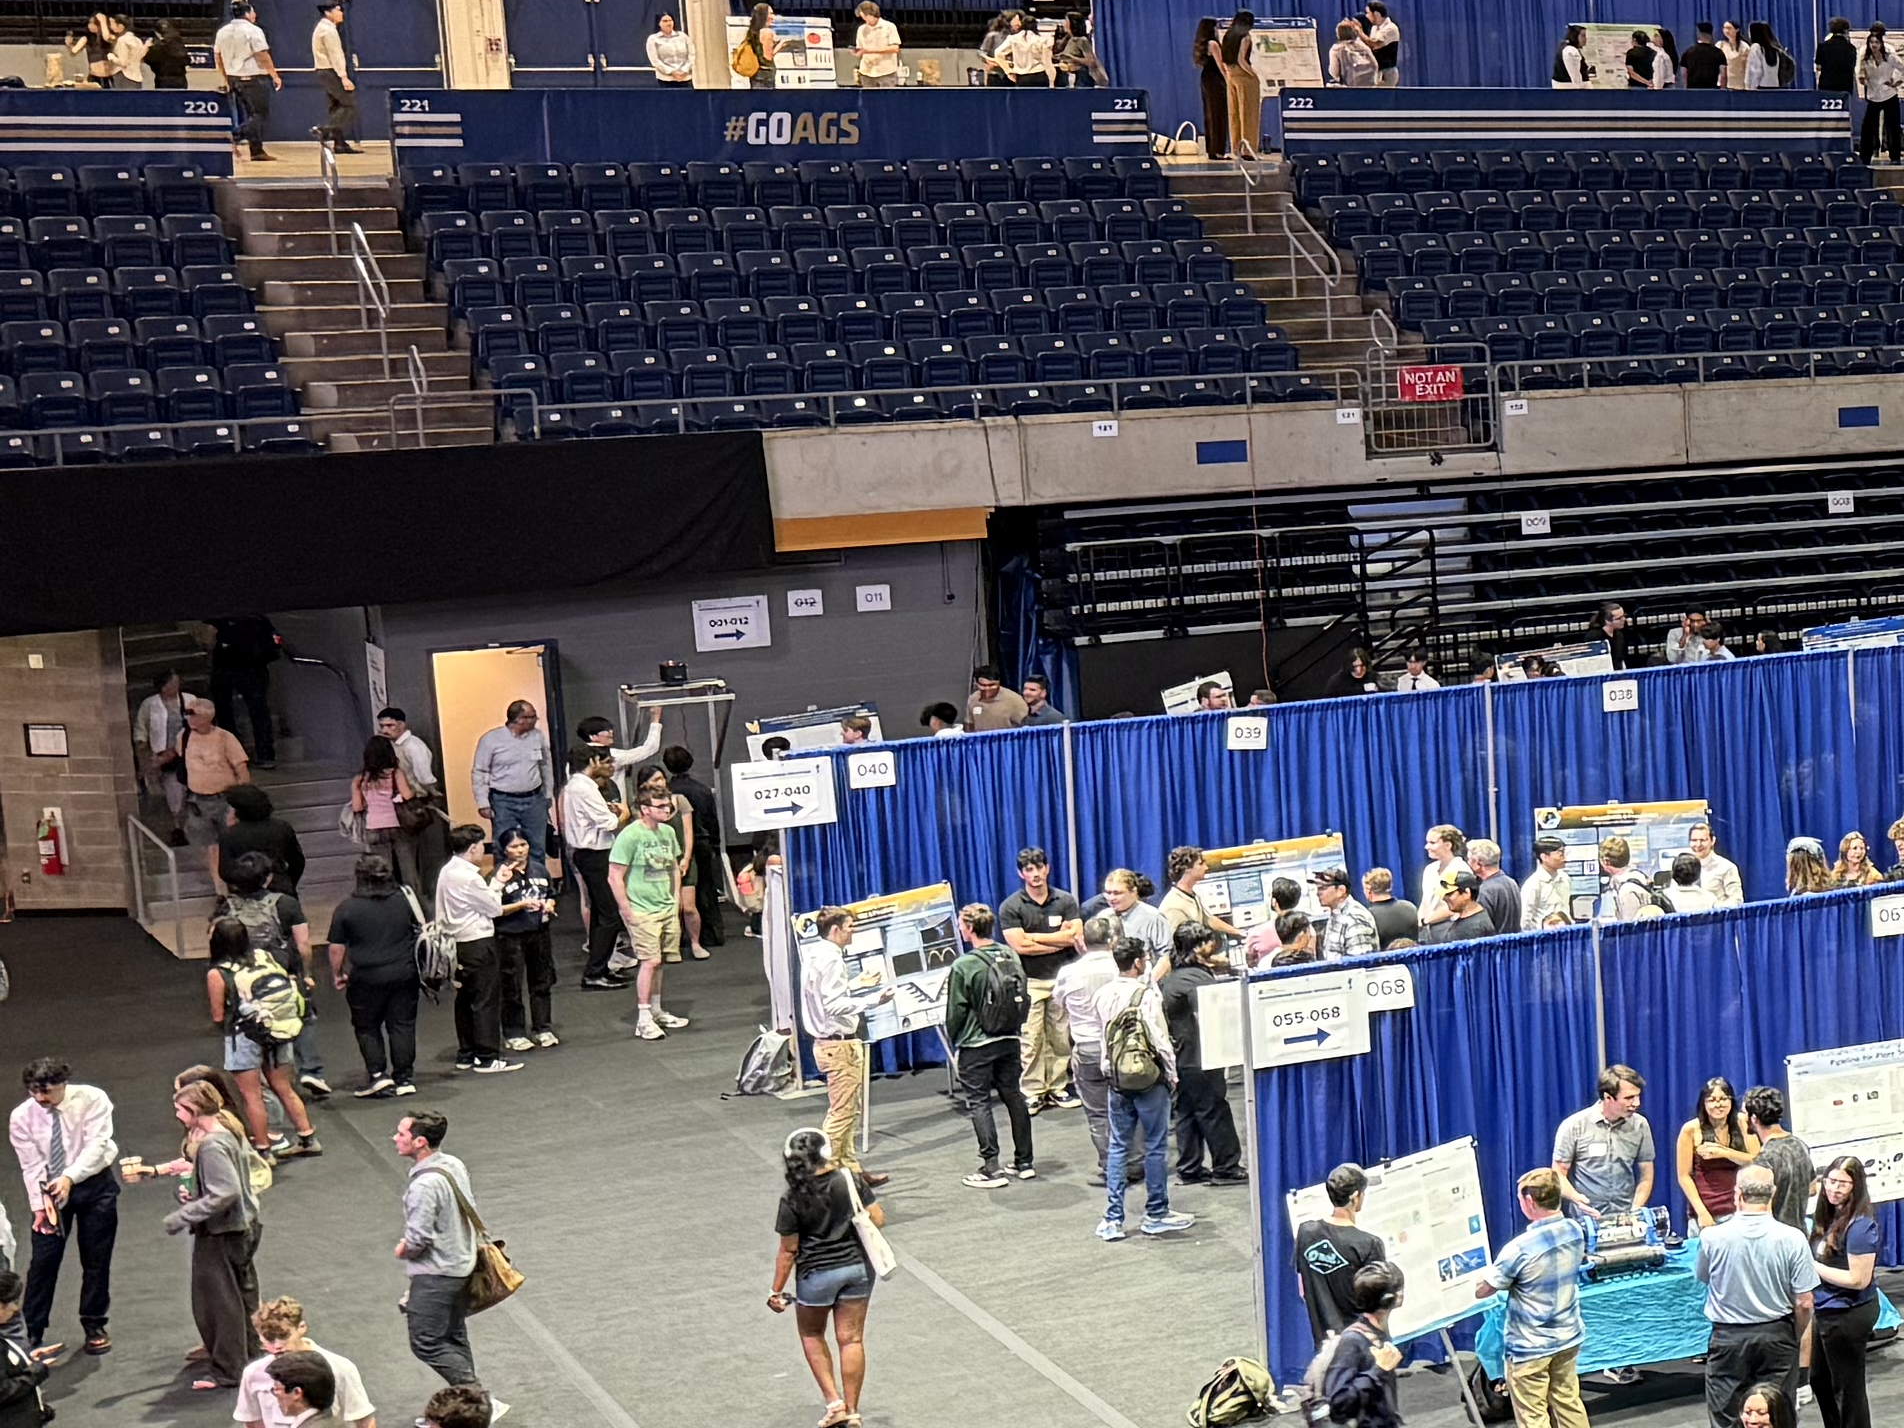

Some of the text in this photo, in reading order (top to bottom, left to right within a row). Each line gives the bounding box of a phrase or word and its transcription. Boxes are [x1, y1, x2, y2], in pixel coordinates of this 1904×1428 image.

[184, 101, 218, 114] 220
[401, 100, 430, 113] 221
[1114, 100, 1138, 110] 221
[1289, 98, 1314, 108] 222
[724, 112, 860, 145] #GOAGS
[1405, 372, 1456, 386] NOT AN
[1416, 384, 1446, 396] EXIT
[865, 592, 882, 604] 011
[1610, 690, 1634, 702] 038
[1234, 726, 1262, 740] 039
[858, 764, 889, 778] 040
[754, 785, 812, 800] 027-040
[1367, 978, 1406, 997] 068
[1273, 1006, 1341, 1028] 055-068
